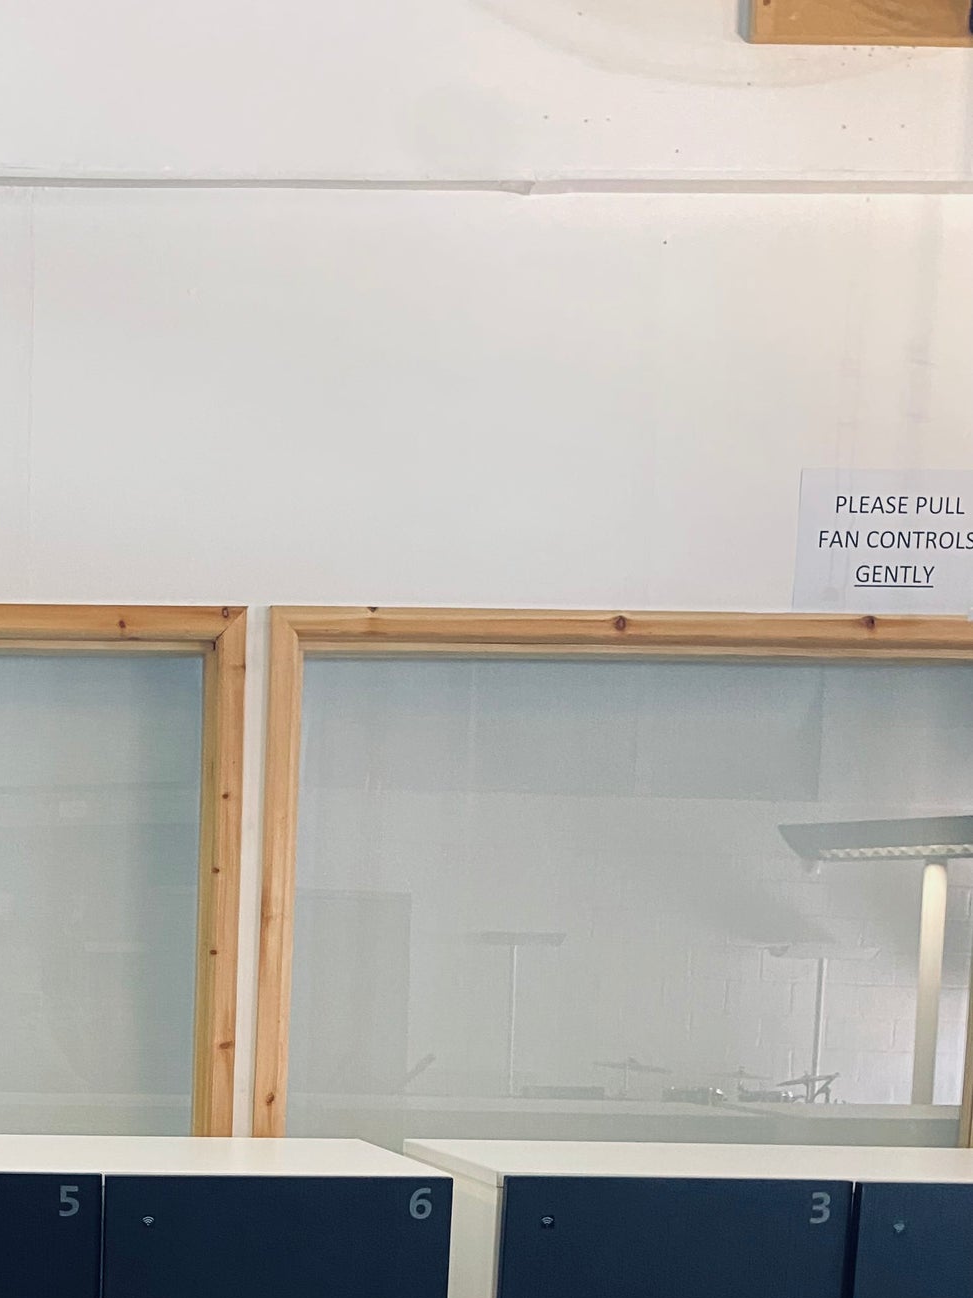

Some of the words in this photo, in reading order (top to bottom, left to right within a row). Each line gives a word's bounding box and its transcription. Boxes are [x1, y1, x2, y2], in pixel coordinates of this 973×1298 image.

[835, 495, 909, 514] PLEASE
[915, 496, 965, 514] PULL
[818, 530, 859, 548] FAN
[866, 531, 973, 550] CONTROLS
[855, 565, 935, 584] GENTLY
[57, 1185, 80, 1217] 5
[408, 1187, 432, 1220] 6
[809, 1191, 831, 1224] 3
